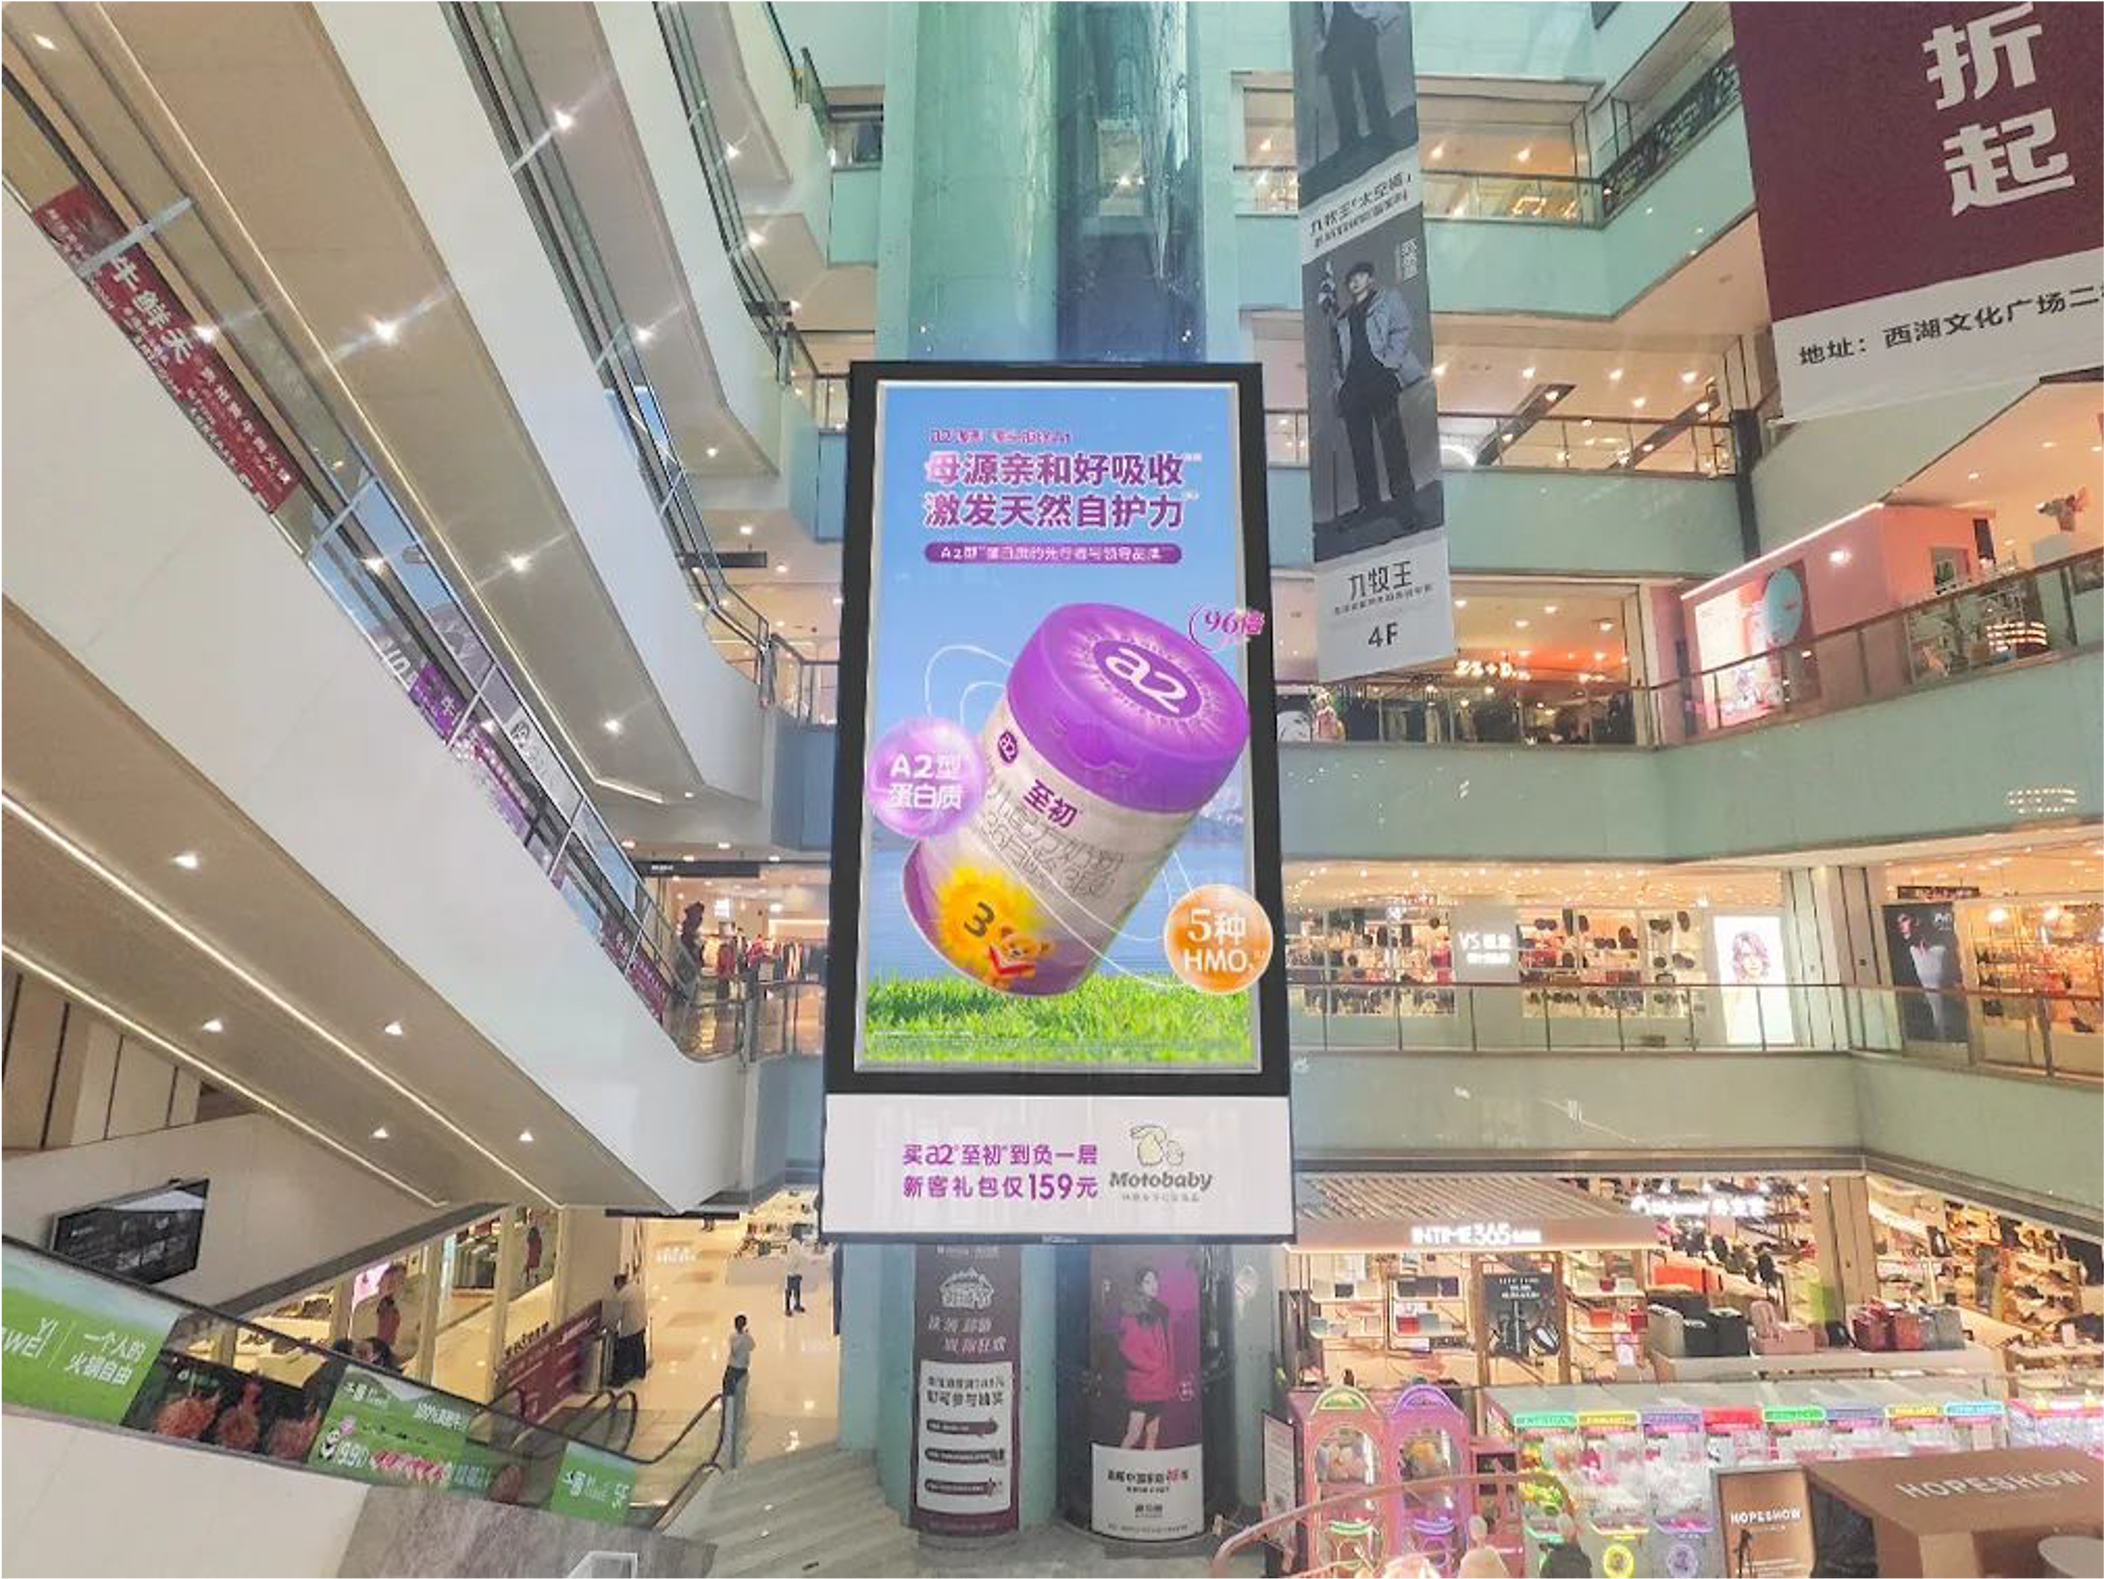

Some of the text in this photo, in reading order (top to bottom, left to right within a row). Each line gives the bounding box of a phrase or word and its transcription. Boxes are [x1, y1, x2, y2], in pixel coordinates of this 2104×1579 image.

[926, 451, 1184, 487] 母源亲和好吸收
[924, 492, 1184, 527] 激发天然自护力
[1348, 561, 1412, 601] 九牧王
[1368, 622, 1398, 648] 4F
[1105, 646, 1189, 714] a2
[883, 783, 963, 811] 蛋白质
[1022, 778, 1079, 829] 至初
[964, 902, 996, 938] 3
[1187, 907, 1247, 946] 5种
[903, 1173, 1098, 1201] 新客礼包仅159元
[1109, 1171, 1213, 1192] Motobaby
[1896, 1469, 2088, 1498] HOPESHOW
